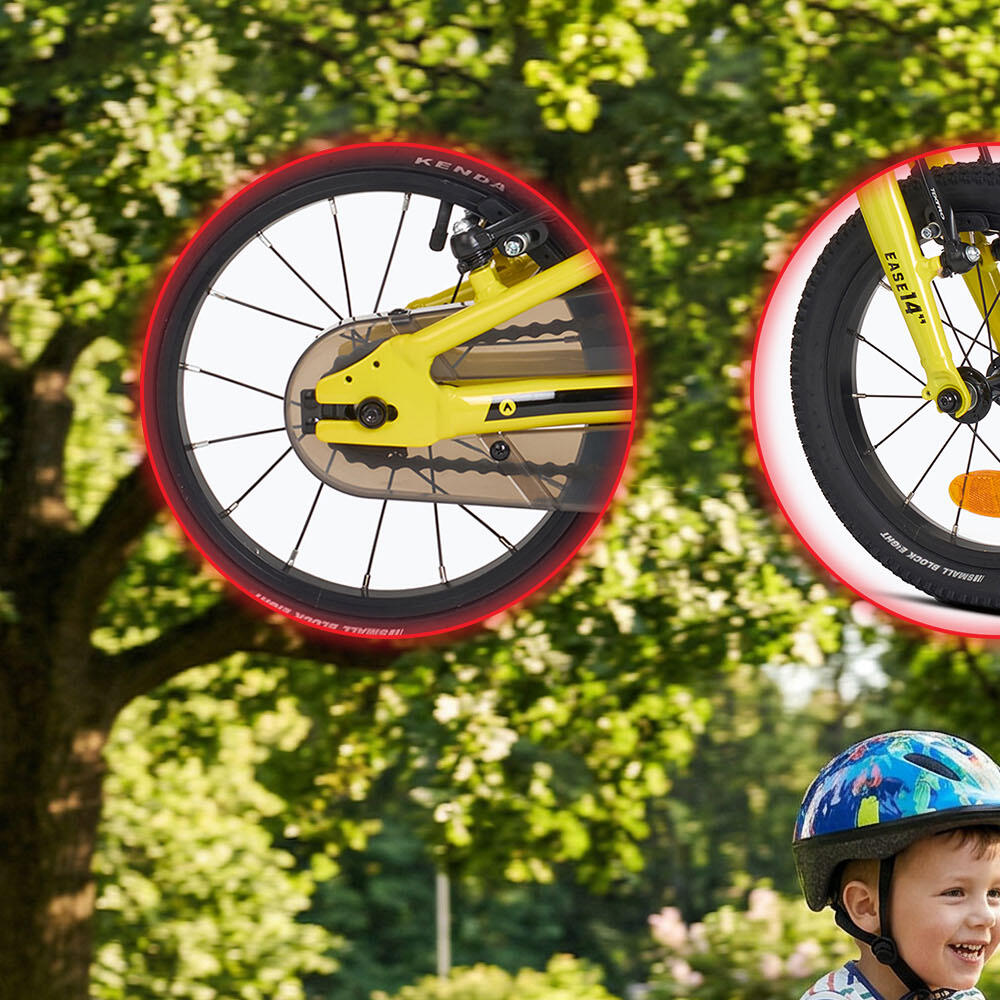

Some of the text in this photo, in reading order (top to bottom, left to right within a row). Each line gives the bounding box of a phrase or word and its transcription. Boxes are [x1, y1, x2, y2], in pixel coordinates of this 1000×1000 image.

[415, 157, 505, 192] KENDA
[884, 252, 909, 292] EASE
[880, 532, 976, 581] SMALL BLOCK EIGHT
